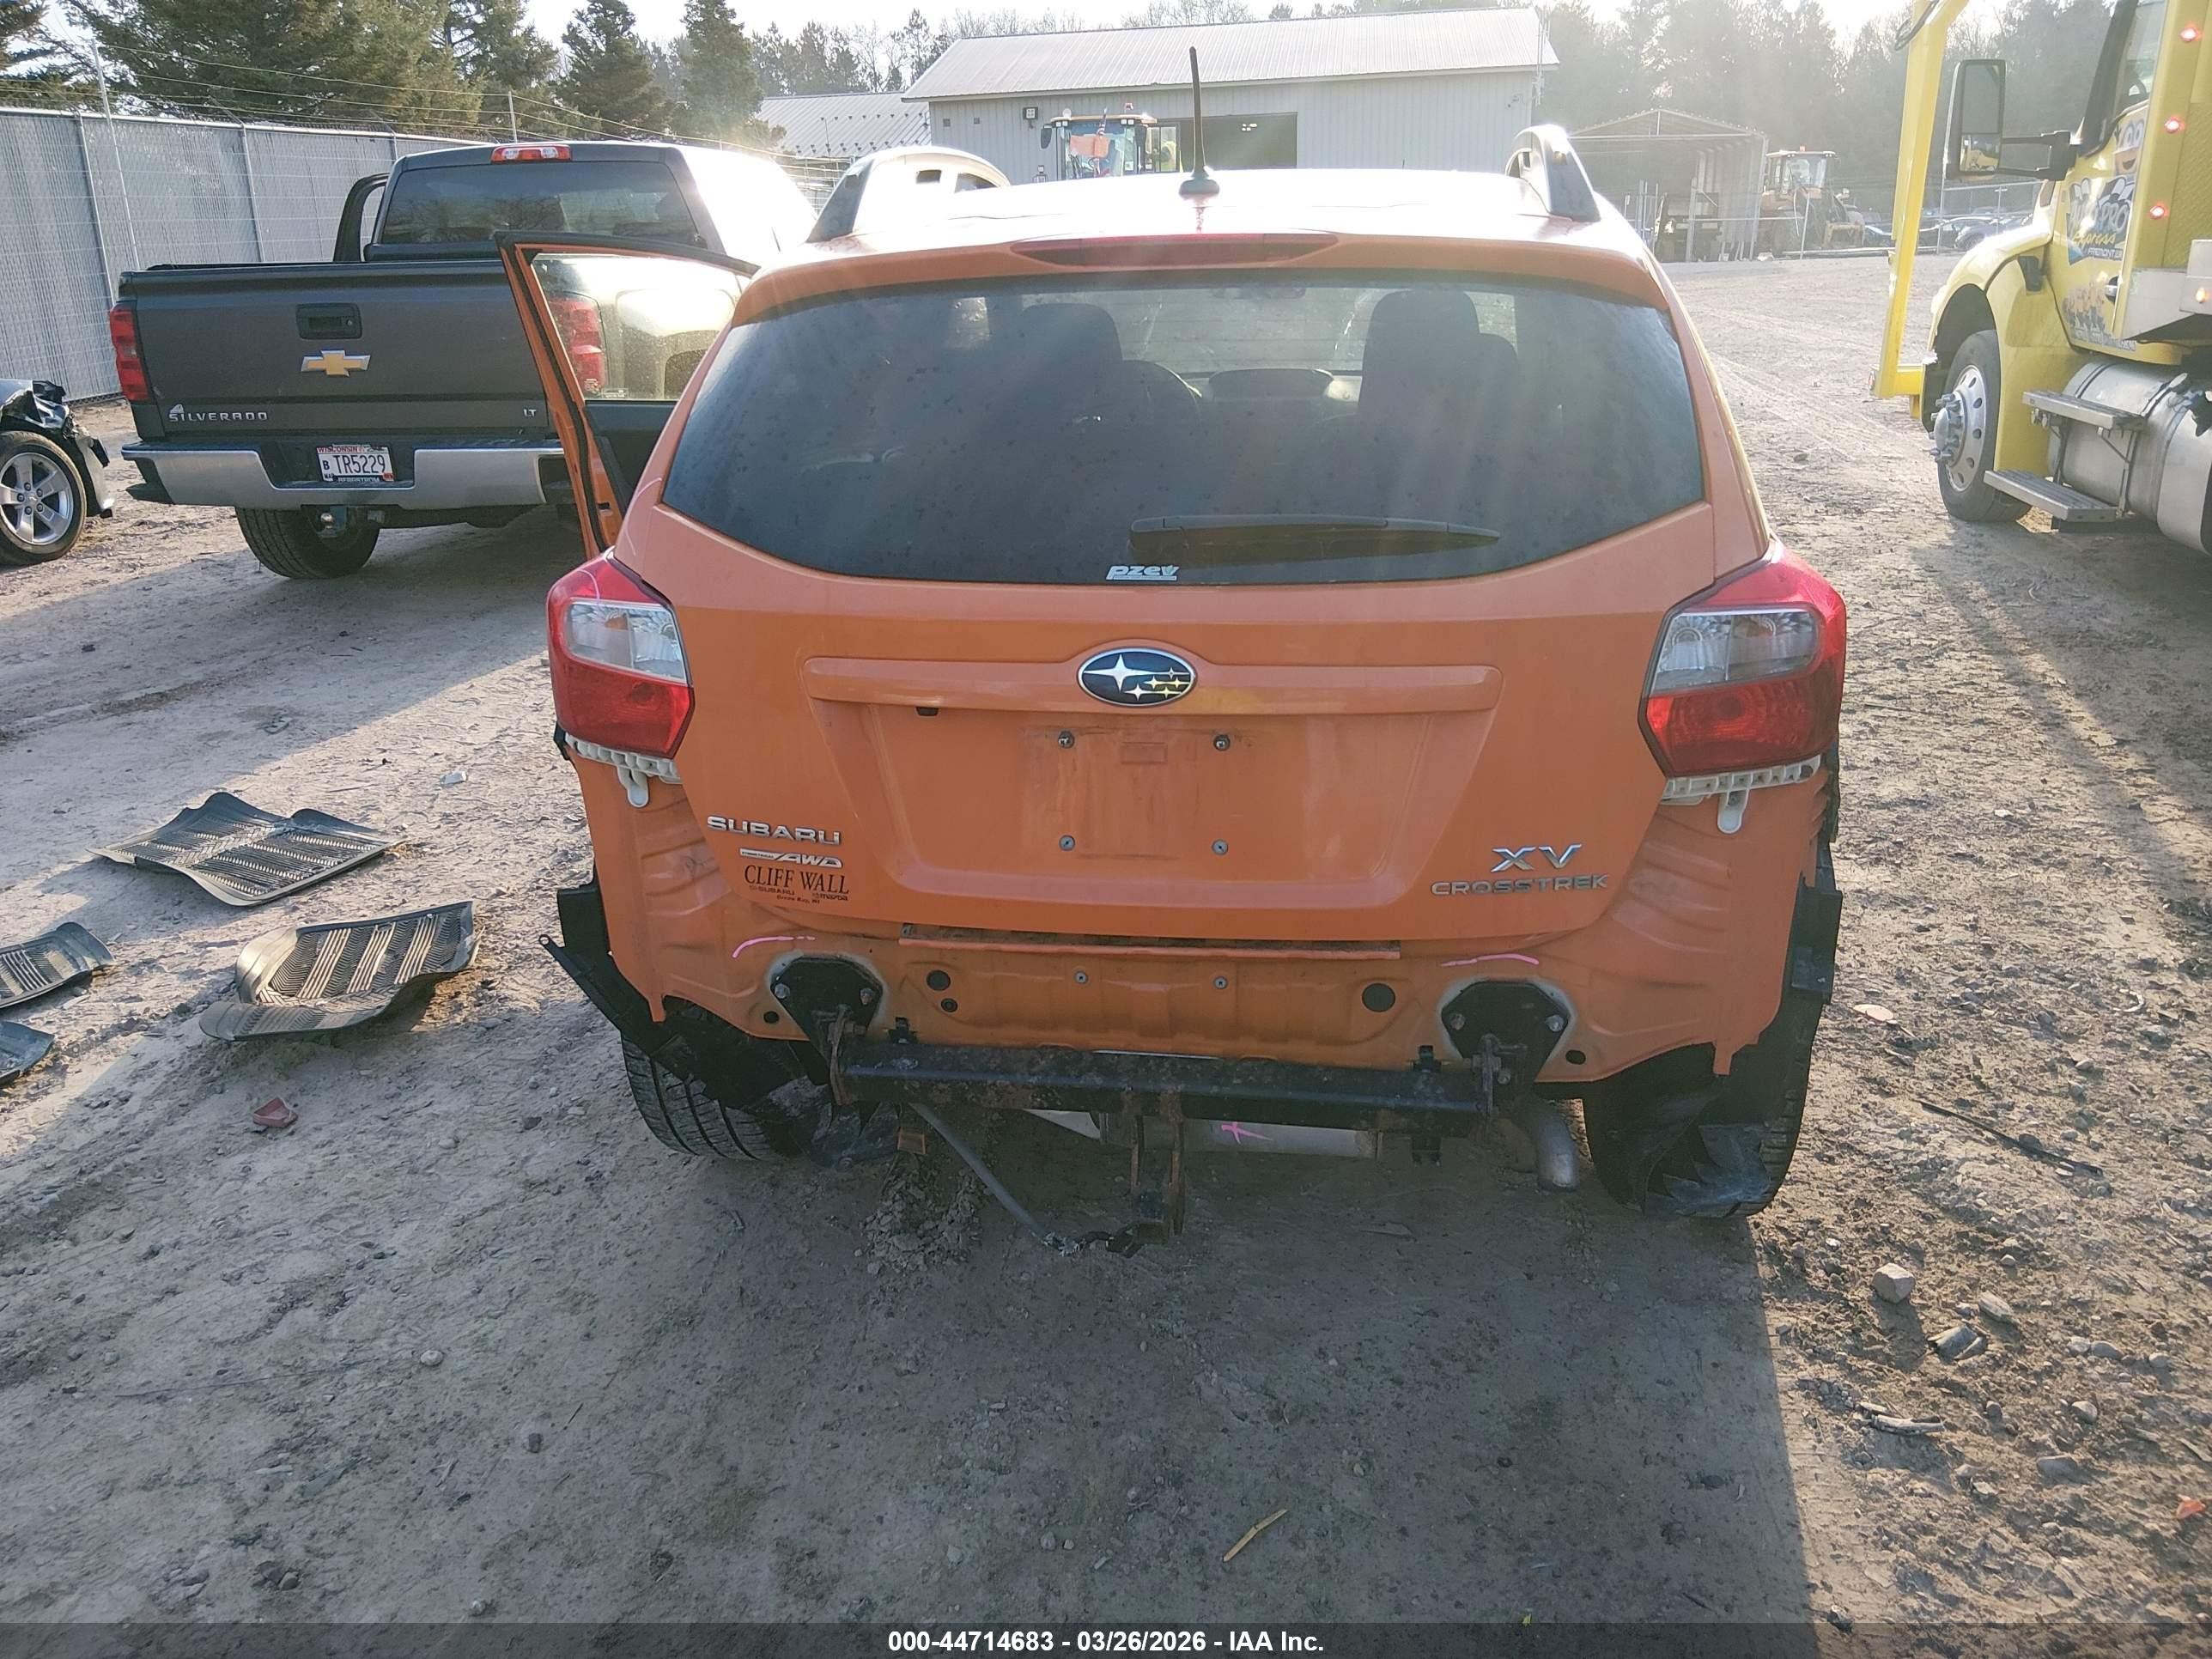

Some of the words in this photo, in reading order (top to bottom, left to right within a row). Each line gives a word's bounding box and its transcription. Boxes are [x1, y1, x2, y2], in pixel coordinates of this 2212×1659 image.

[168, 411, 268, 422] SILVERADO
[523, 408, 537, 417] LT
[322, 460, 330, 471] B
[332, 454, 386, 474] TR5229
[707, 816, 841, 846] SUBARU
[776, 853, 842, 868] AWD
[1491, 843, 1583, 872] XV
[744, 865, 794, 888] CLIFF
[799, 871, 850, 895] WALL
[1431, 874, 1609, 896] CROSSTREK
